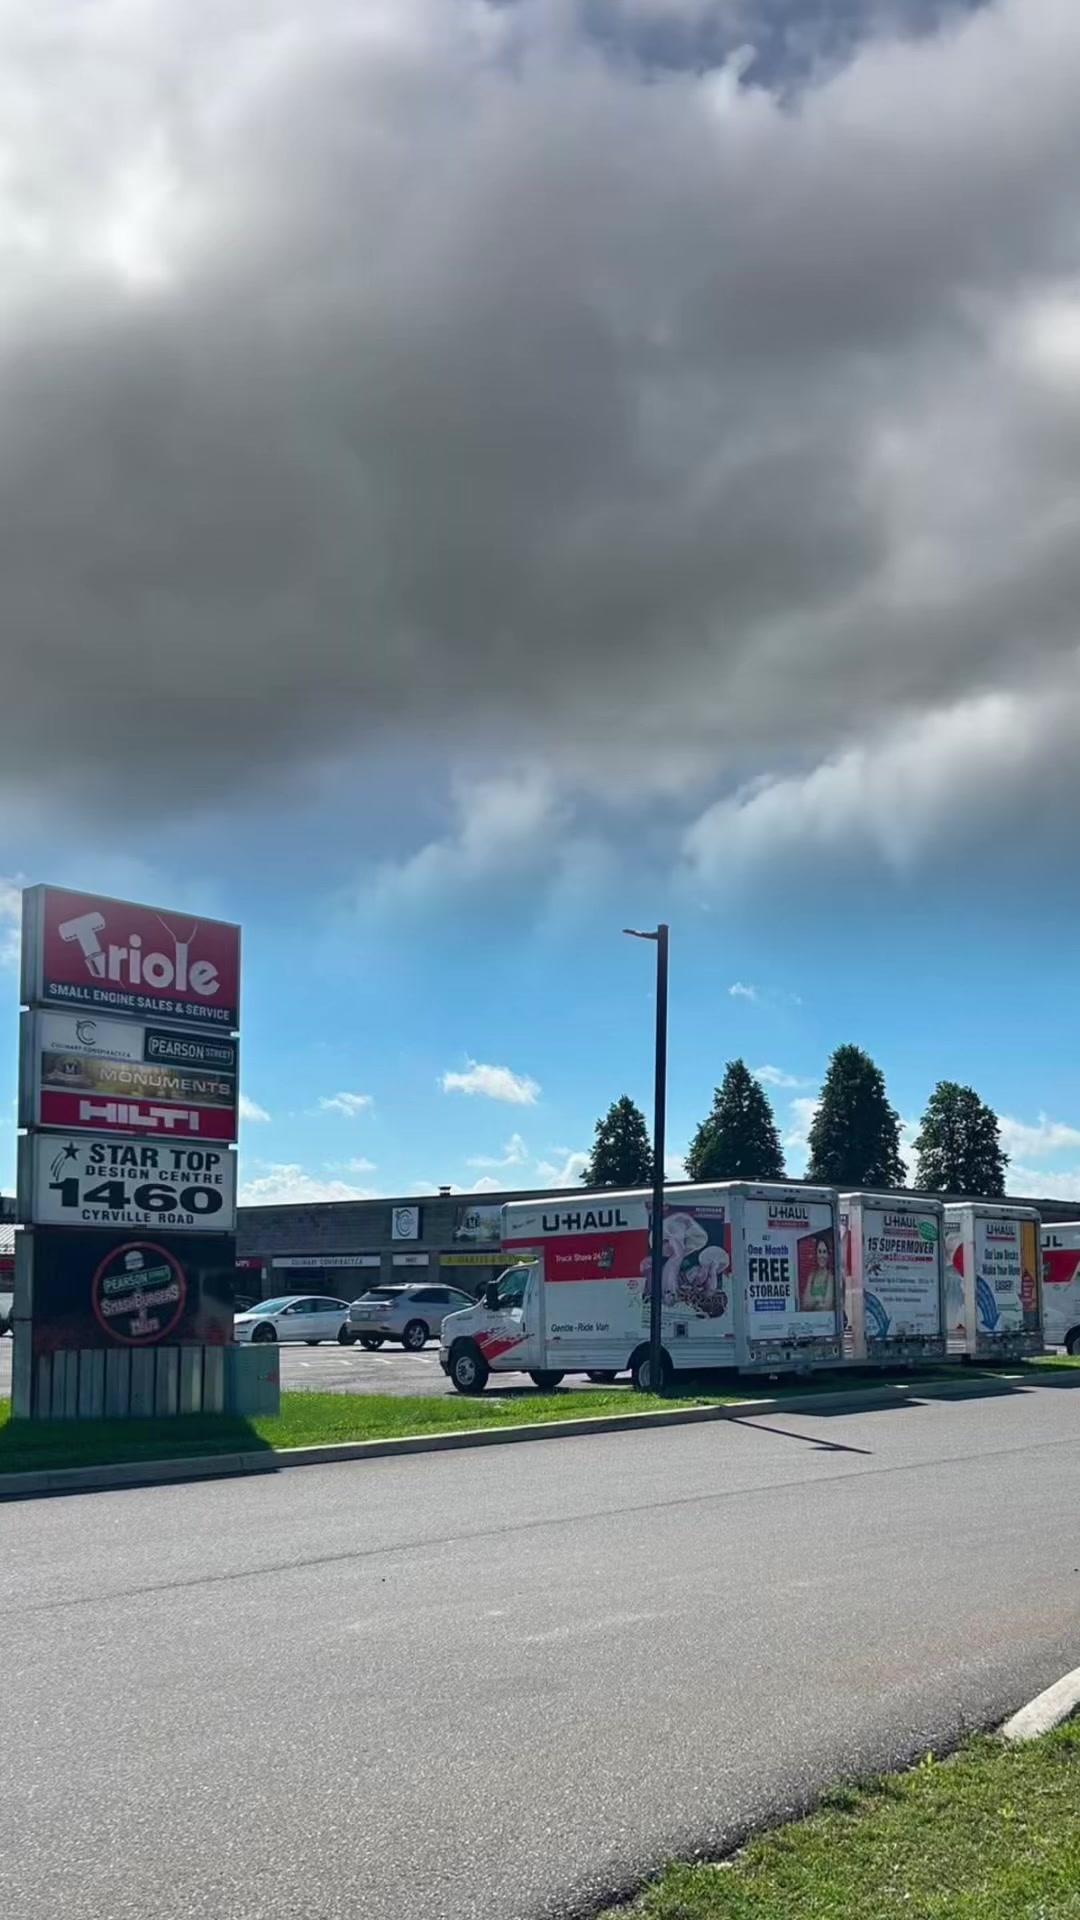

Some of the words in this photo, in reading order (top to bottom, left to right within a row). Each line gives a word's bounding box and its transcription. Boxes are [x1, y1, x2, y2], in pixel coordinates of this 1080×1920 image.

[58, 911, 220, 995] Triole
[50, 983, 90, 1000] SMALL
[93, 990, 135, 1006] ENGINE
[137, 997, 173, 1012] SALES
[175, 1002, 184, 1013] &
[186, 1004, 230, 1020] SERVICE
[151, 1039, 204, 1058] PEARSON
[100, 1067, 231, 1095] MONUMENTS
[79, 1100, 199, 1130] HILTI
[89, 1143, 158, 1168] STAR
[170, 1149, 220, 1171] TOP
[85, 1165, 149, 1180] DESIGN
[159, 1170, 223, 1184] CENTRE
[49, 1178, 223, 1214] 1460
[82, 1208, 151, 1222] CYRVILLE
[158, 1213, 194, 1224] ROAD
[765, 1244, 788, 1255] Month
[879, 1238, 934, 1254] SUPERMOVER
[749, 1258, 790, 1282] FREE
[105, 1271, 149, 1291] PEARSON
[749, 1284, 791, 1298] STORAGE
[596, 1322, 609, 1332] Van
